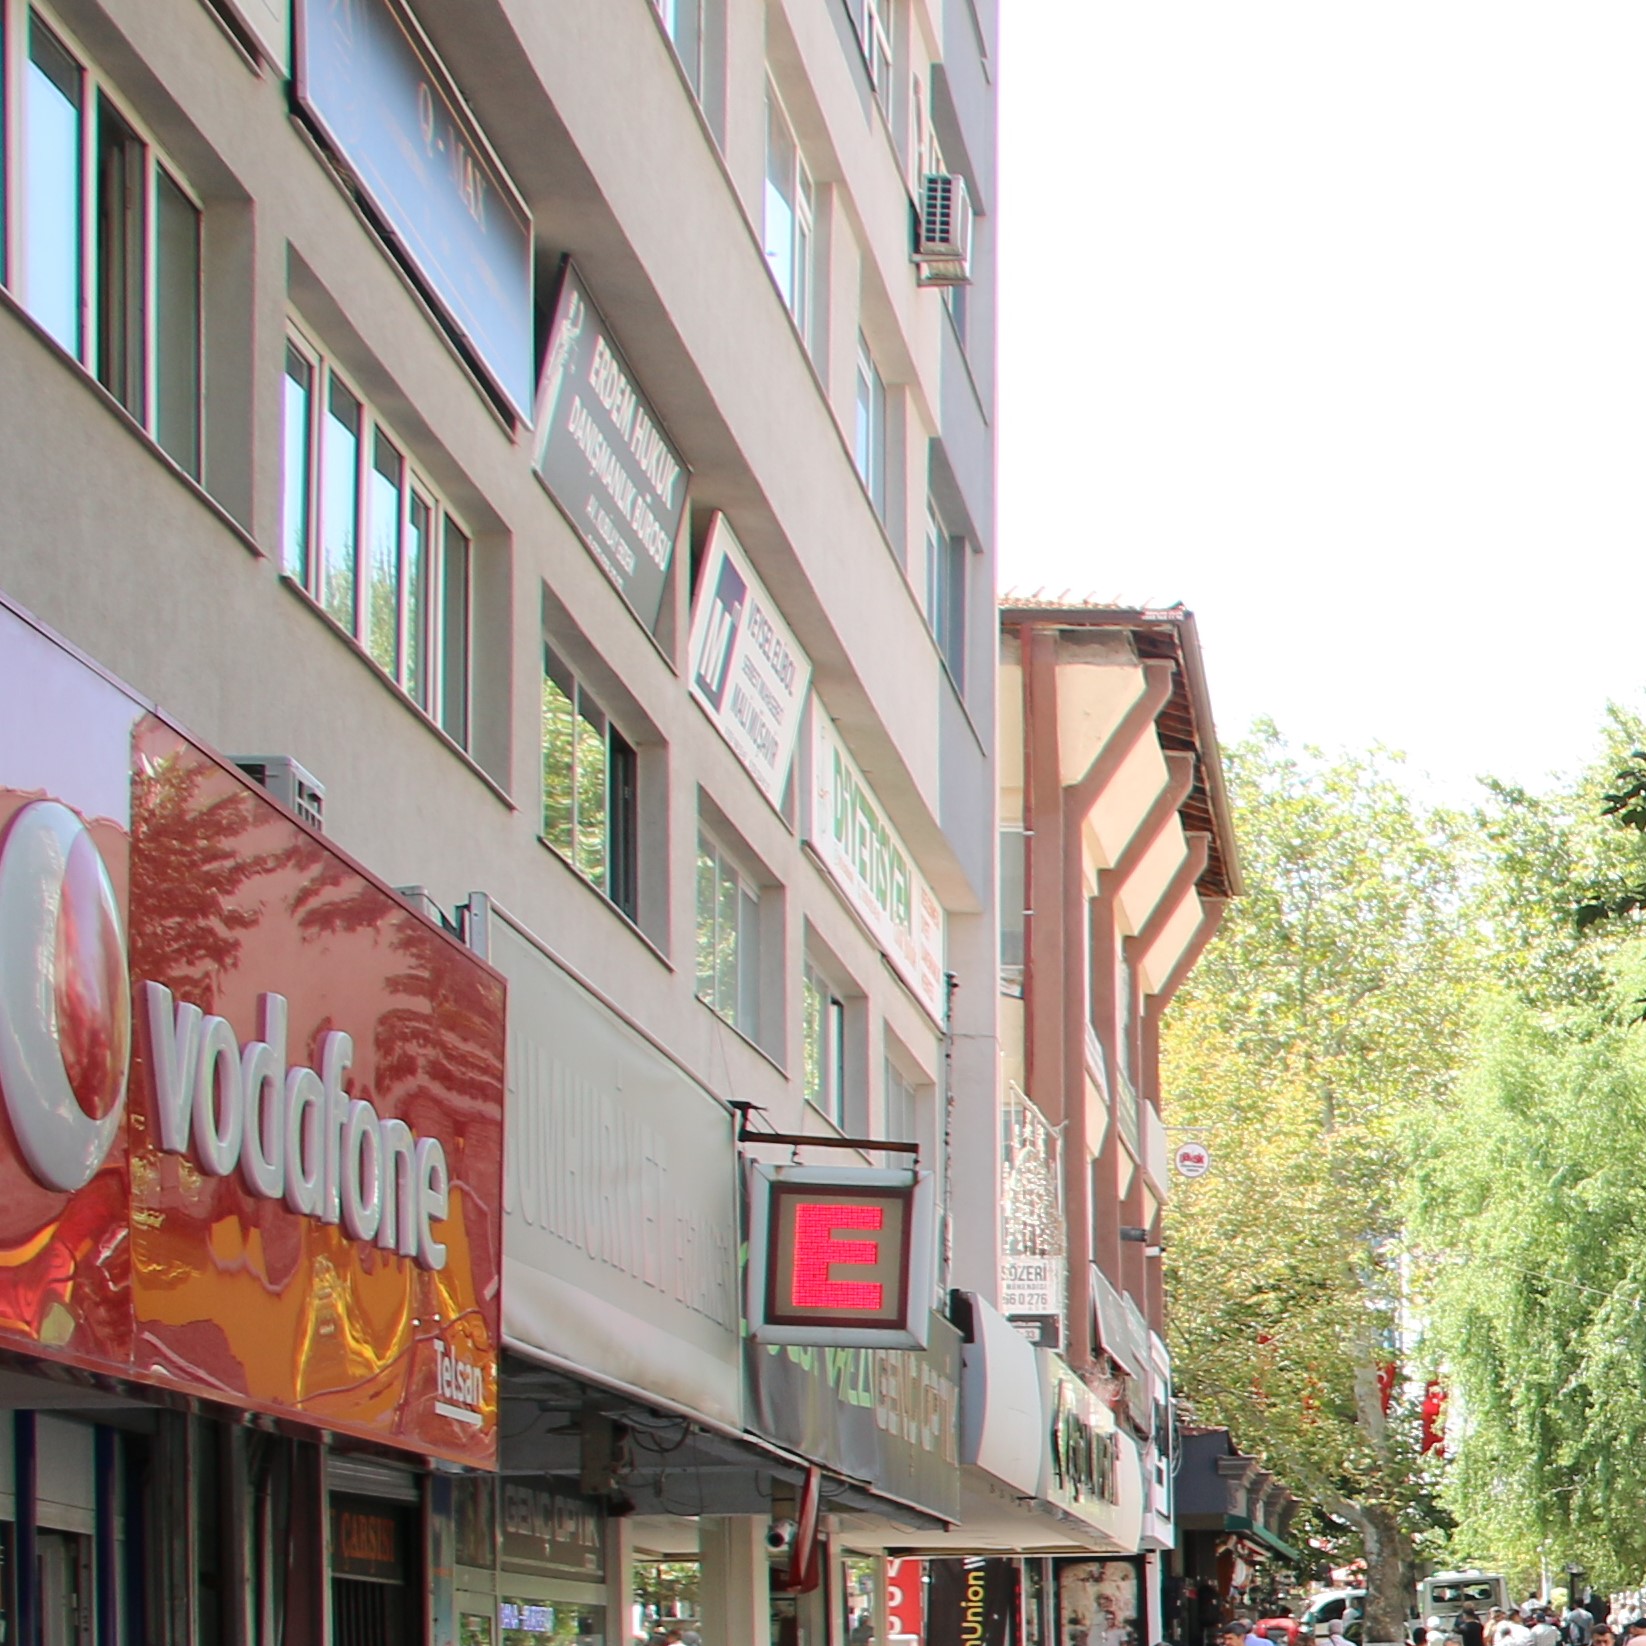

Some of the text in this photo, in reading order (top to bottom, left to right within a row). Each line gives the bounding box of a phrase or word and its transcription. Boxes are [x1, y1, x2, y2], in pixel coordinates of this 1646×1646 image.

[567, 394, 640, 523] DANIŞMANLIK
[588, 333, 681, 511] ERDEM HUKUK
[141, 980, 449, 1272] vodafone
[792, 1203, 883, 1310] E
[433, 1338, 483, 1407] Telsan
